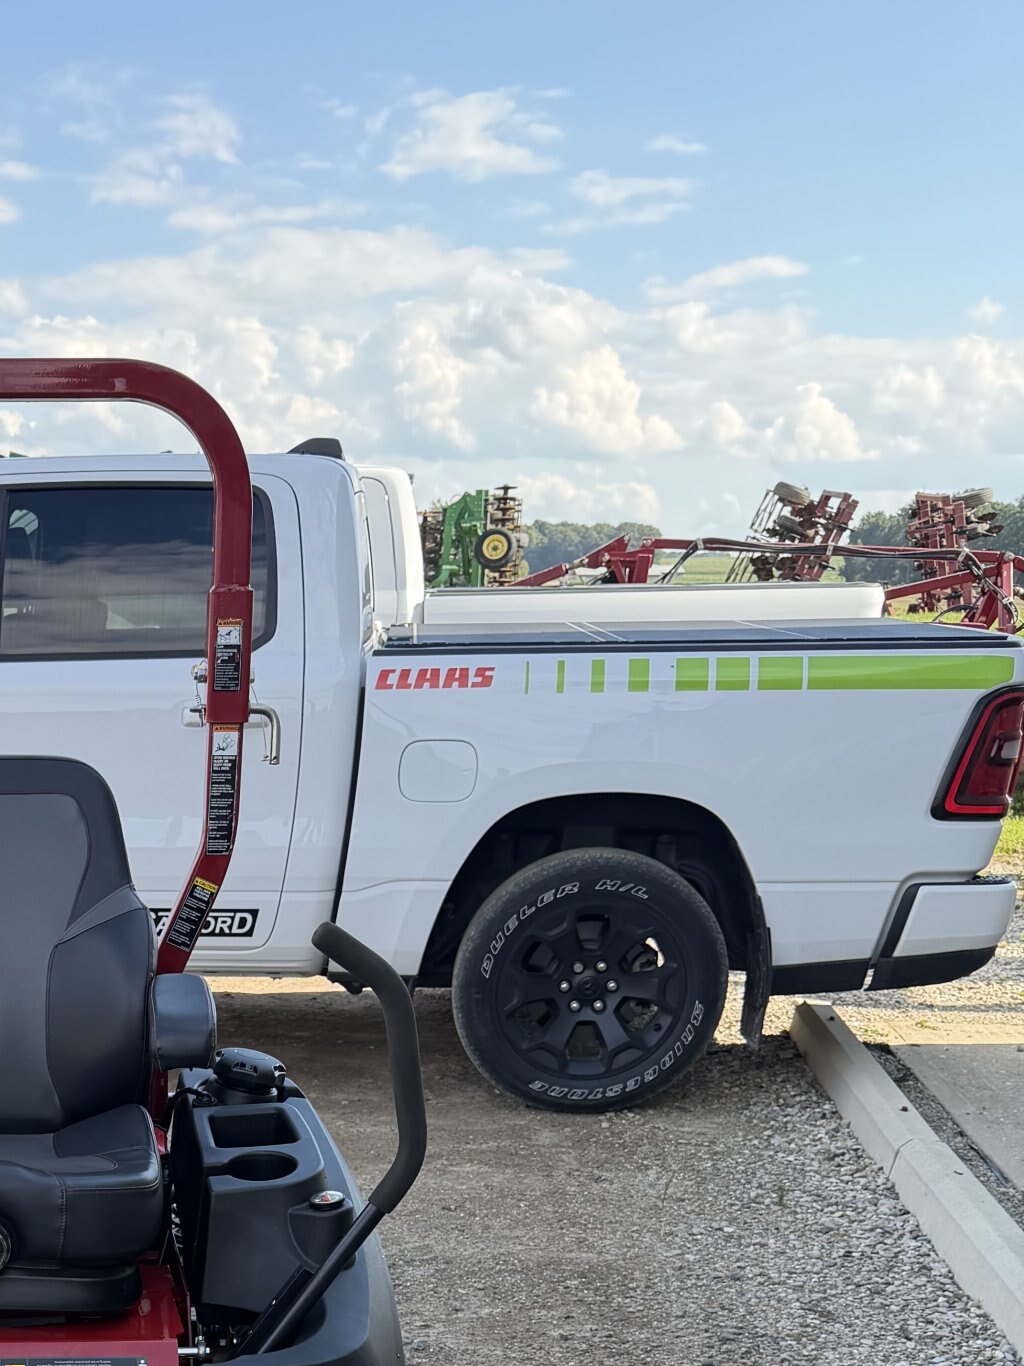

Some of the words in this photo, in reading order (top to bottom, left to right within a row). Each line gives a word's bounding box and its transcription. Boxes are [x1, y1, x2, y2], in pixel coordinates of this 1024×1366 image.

[374, 667, 495, 690] CLAAS
[480, 882, 579, 978] DUELER
[595, 879, 649, 899] H/L
[528, 1000, 704, 1100] BRIDGESTONE
